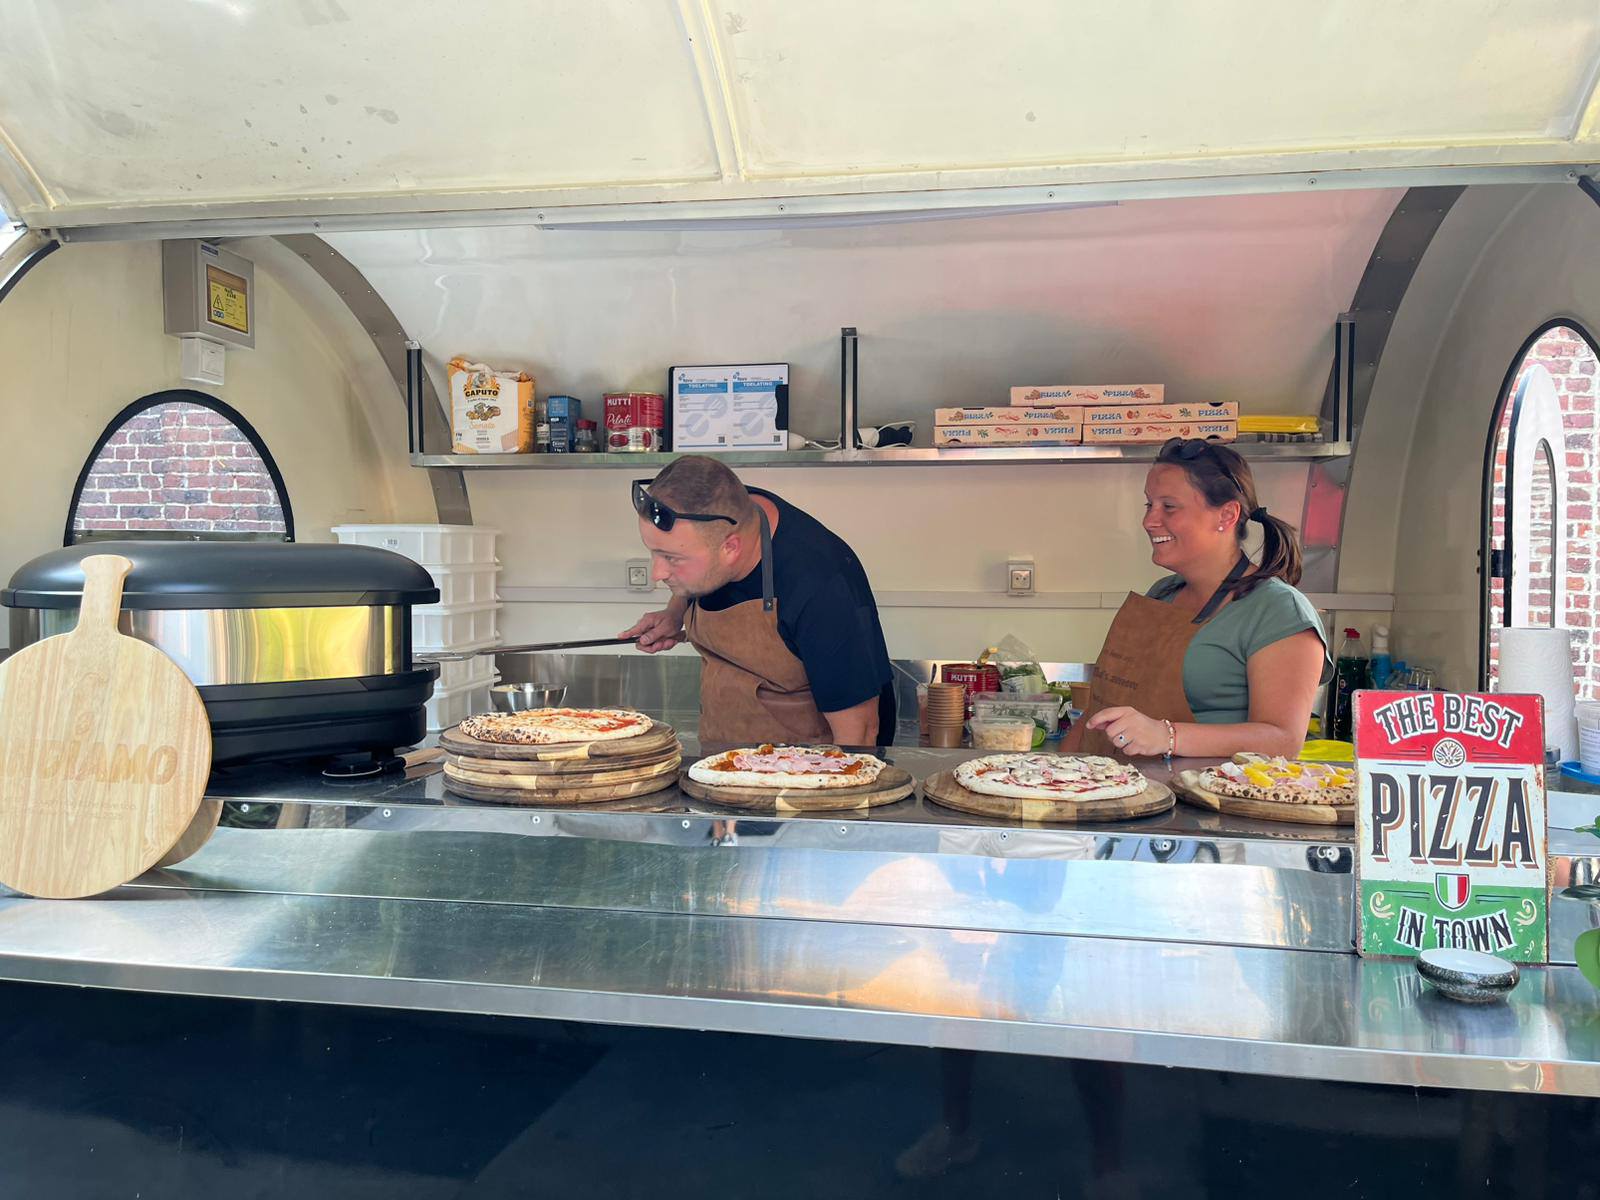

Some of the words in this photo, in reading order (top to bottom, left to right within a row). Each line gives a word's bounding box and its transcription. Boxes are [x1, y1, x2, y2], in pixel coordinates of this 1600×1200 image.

[465, 389, 498, 397] CAPUTO
[607, 398, 631, 406] MUTTI
[1091, 412, 1122, 420] PIZZA
[1198, 409, 1230, 417] PIZZA
[942, 429, 971, 437] PIZZA
[1044, 426, 1074, 435] PIZZA
[1091, 427, 1122, 435] PIZZA
[1198, 425, 1230, 433] PIZZA
[950, 674, 977, 682] MUTTI
[1374, 694, 1437, 744] THE
[1443, 693, 1523, 748] BEST
[1369, 772, 1538, 869] PIZZA
[1394, 906, 1427, 949] IN
[1432, 909, 1518, 951] TOWN
